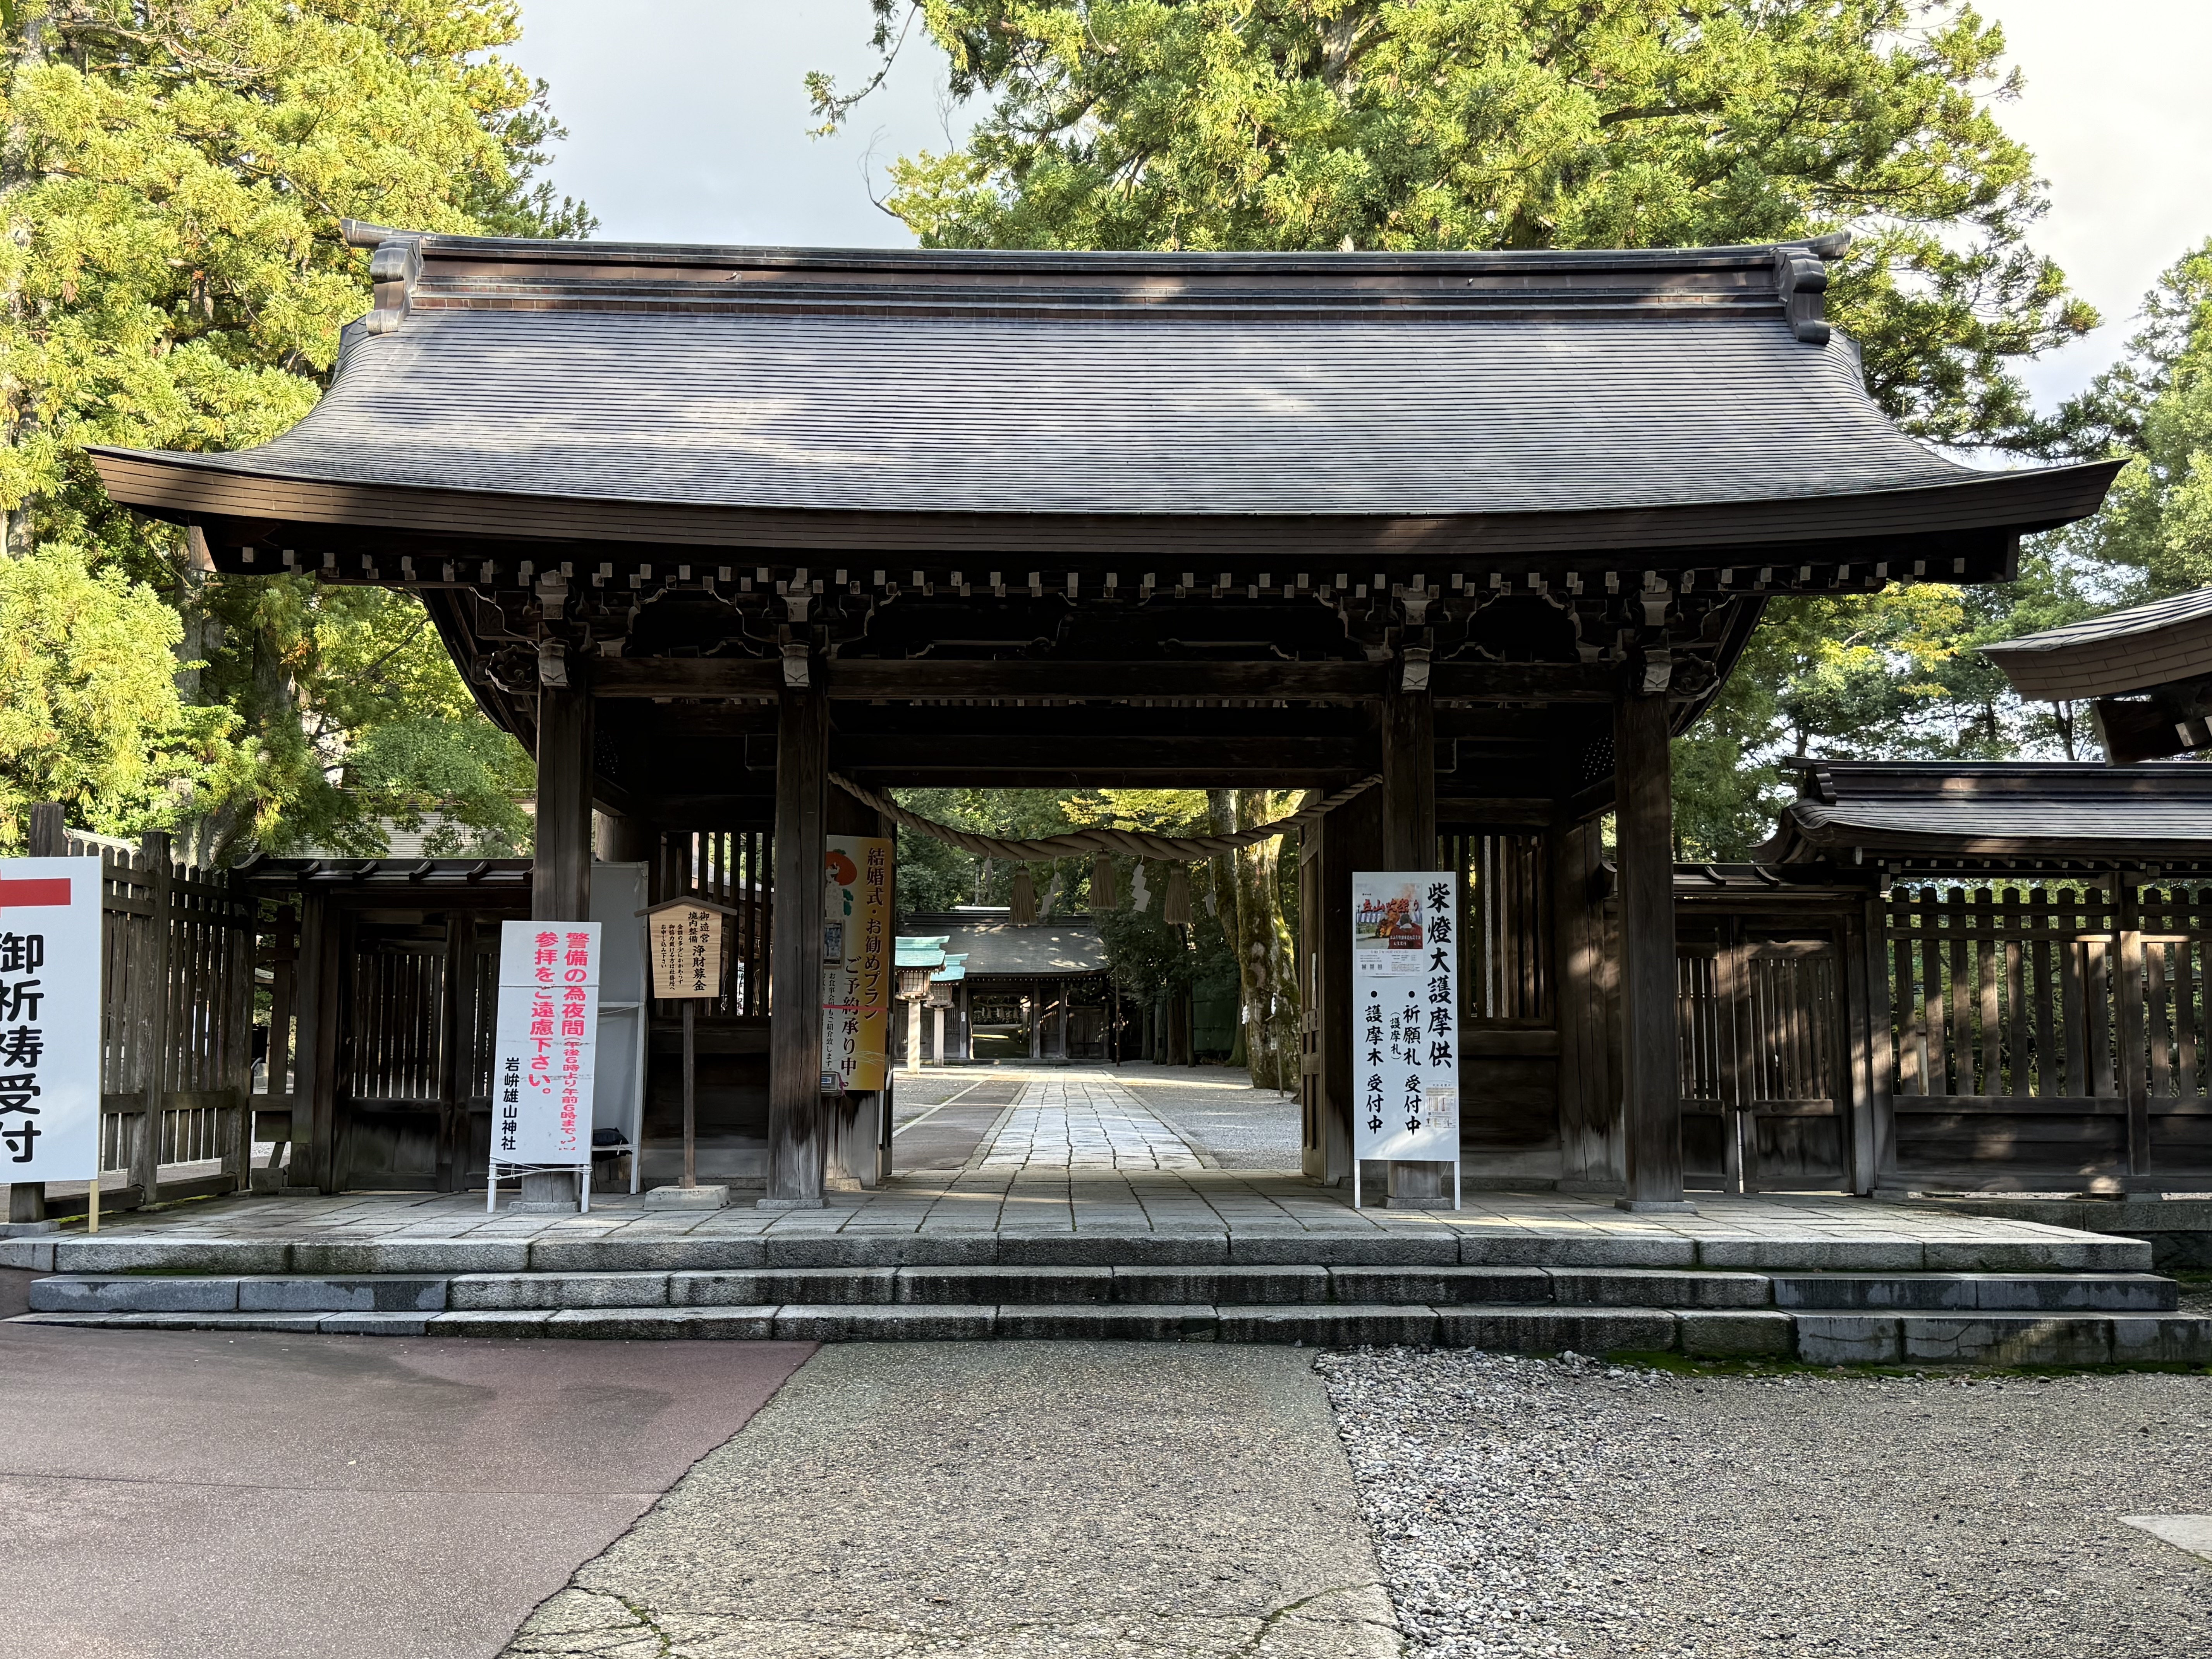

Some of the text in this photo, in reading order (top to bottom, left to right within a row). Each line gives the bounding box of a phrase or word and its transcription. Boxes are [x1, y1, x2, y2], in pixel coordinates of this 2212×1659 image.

[688, 911, 697, 943] 境内整備
[692, 945, 707, 991] 浄財募金
[699, 911, 710, 943] 御造営
[864, 848, 884, 1019] 結婚式・お勧めプラン
[1426, 882, 1453, 1068] 柴燈大護摩供
[0, 932, 44, 1163] 御祈祷受付
[1365, 1004, 1384, 1135] 護摩木 受付中
[1390, 1012, 1401, 1060] （護摩札）
[1403, 1004, 1422, 1135] 祈願札 受付中
[501, 1057, 520, 1151] 岩峅雄山神社
